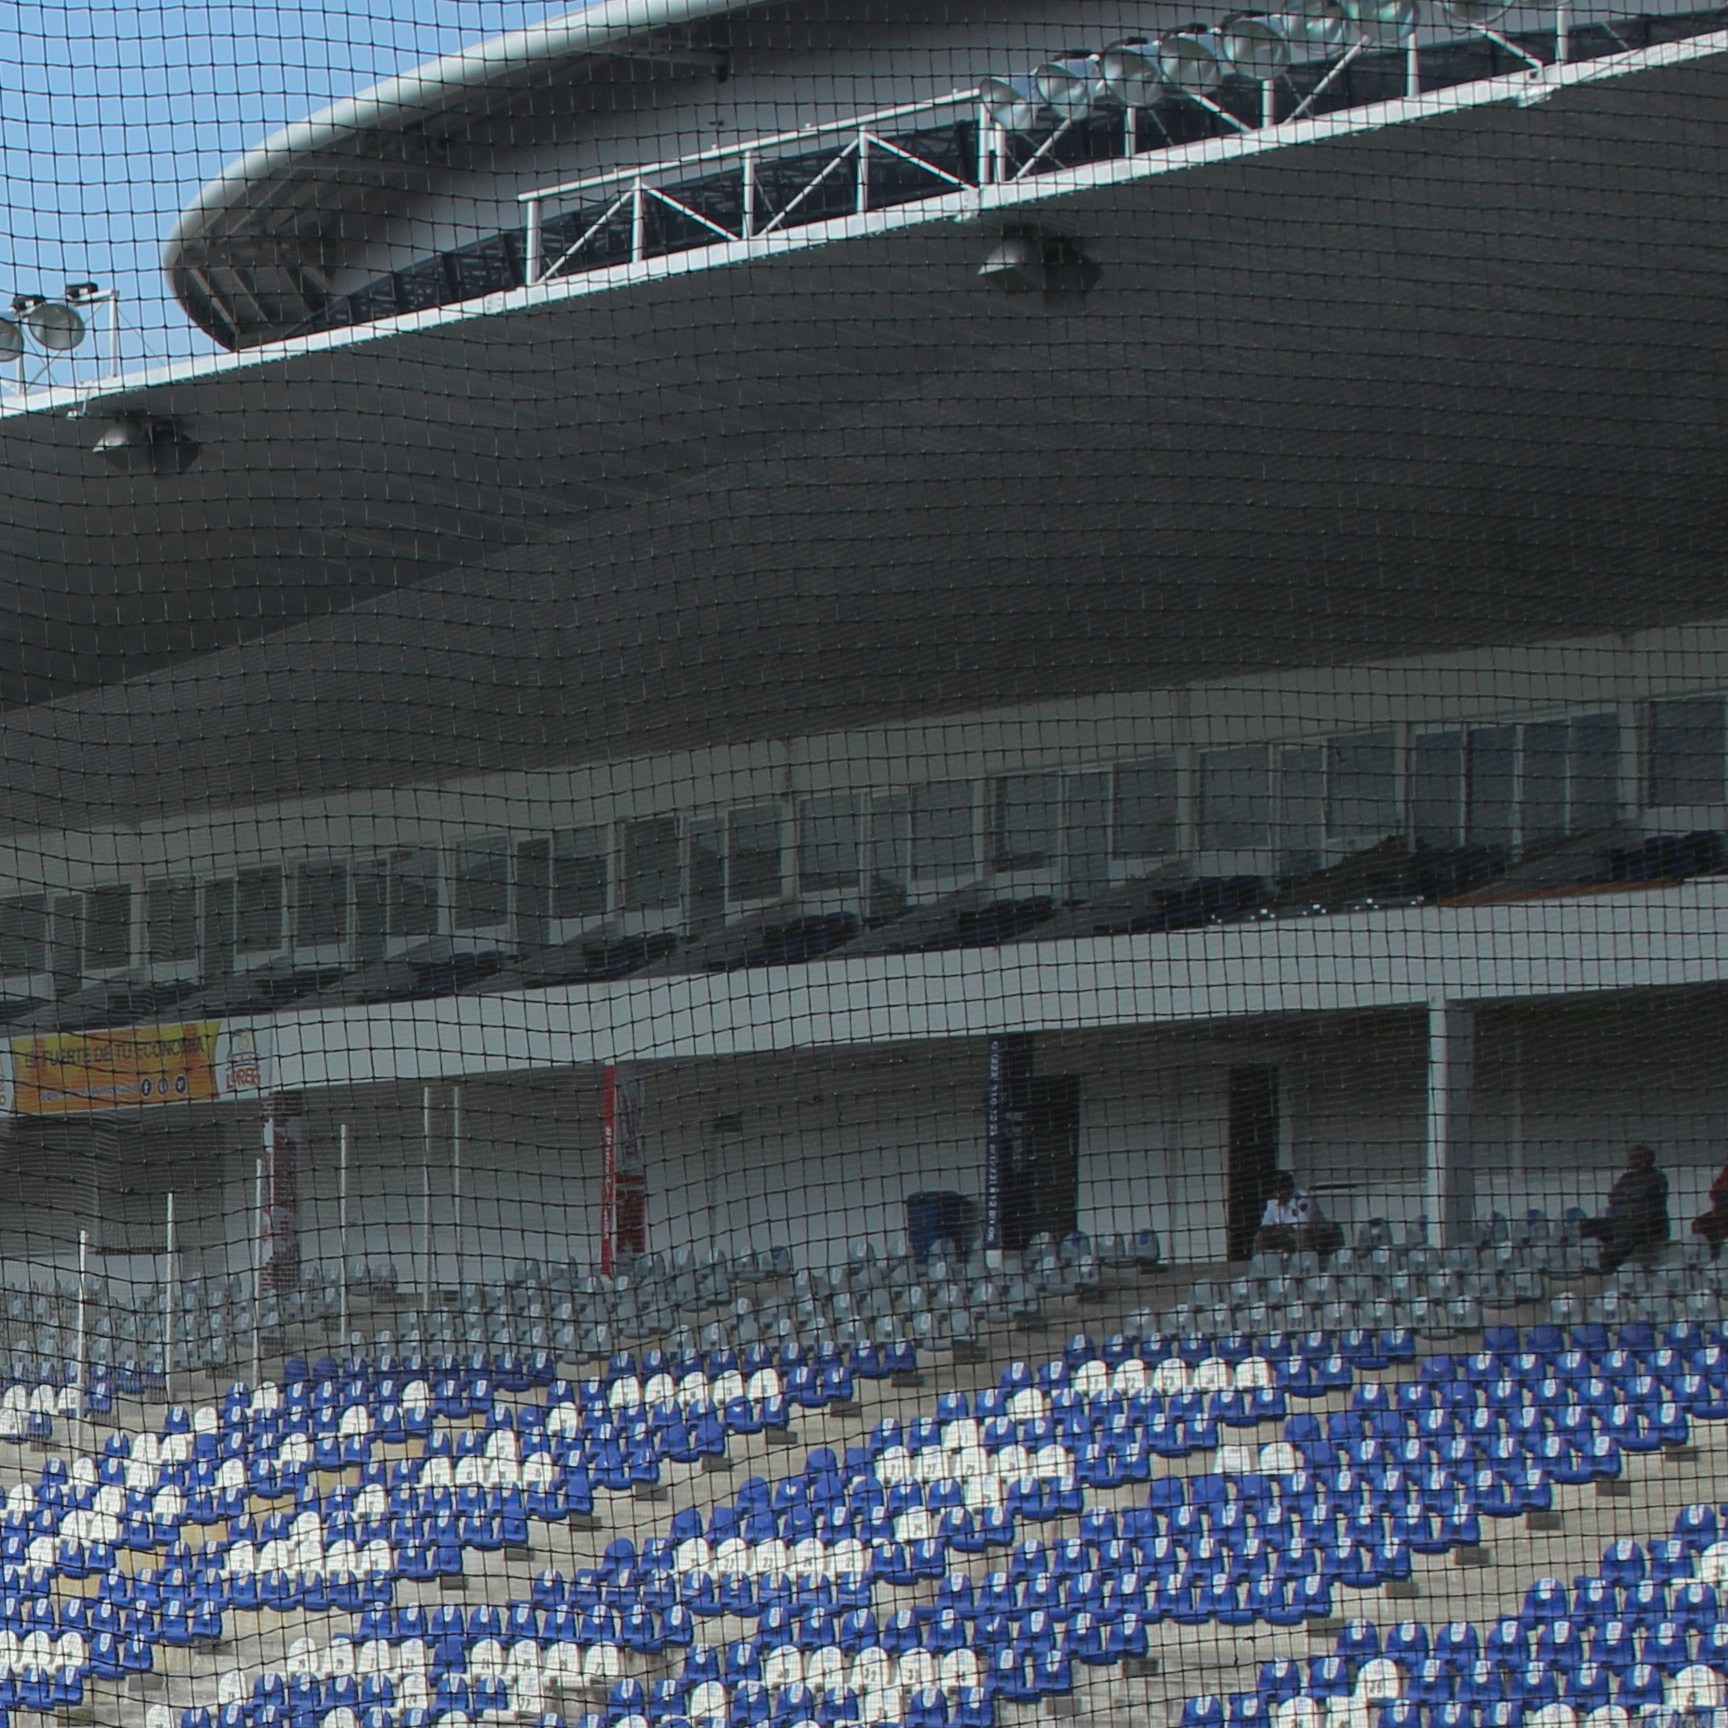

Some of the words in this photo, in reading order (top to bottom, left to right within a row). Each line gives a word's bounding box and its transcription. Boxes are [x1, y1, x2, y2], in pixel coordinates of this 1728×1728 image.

[44, 1046, 92, 1067] FUERTE
[95, 1045, 112, 1063] DE
[114, 1043, 132, 1061] TU
